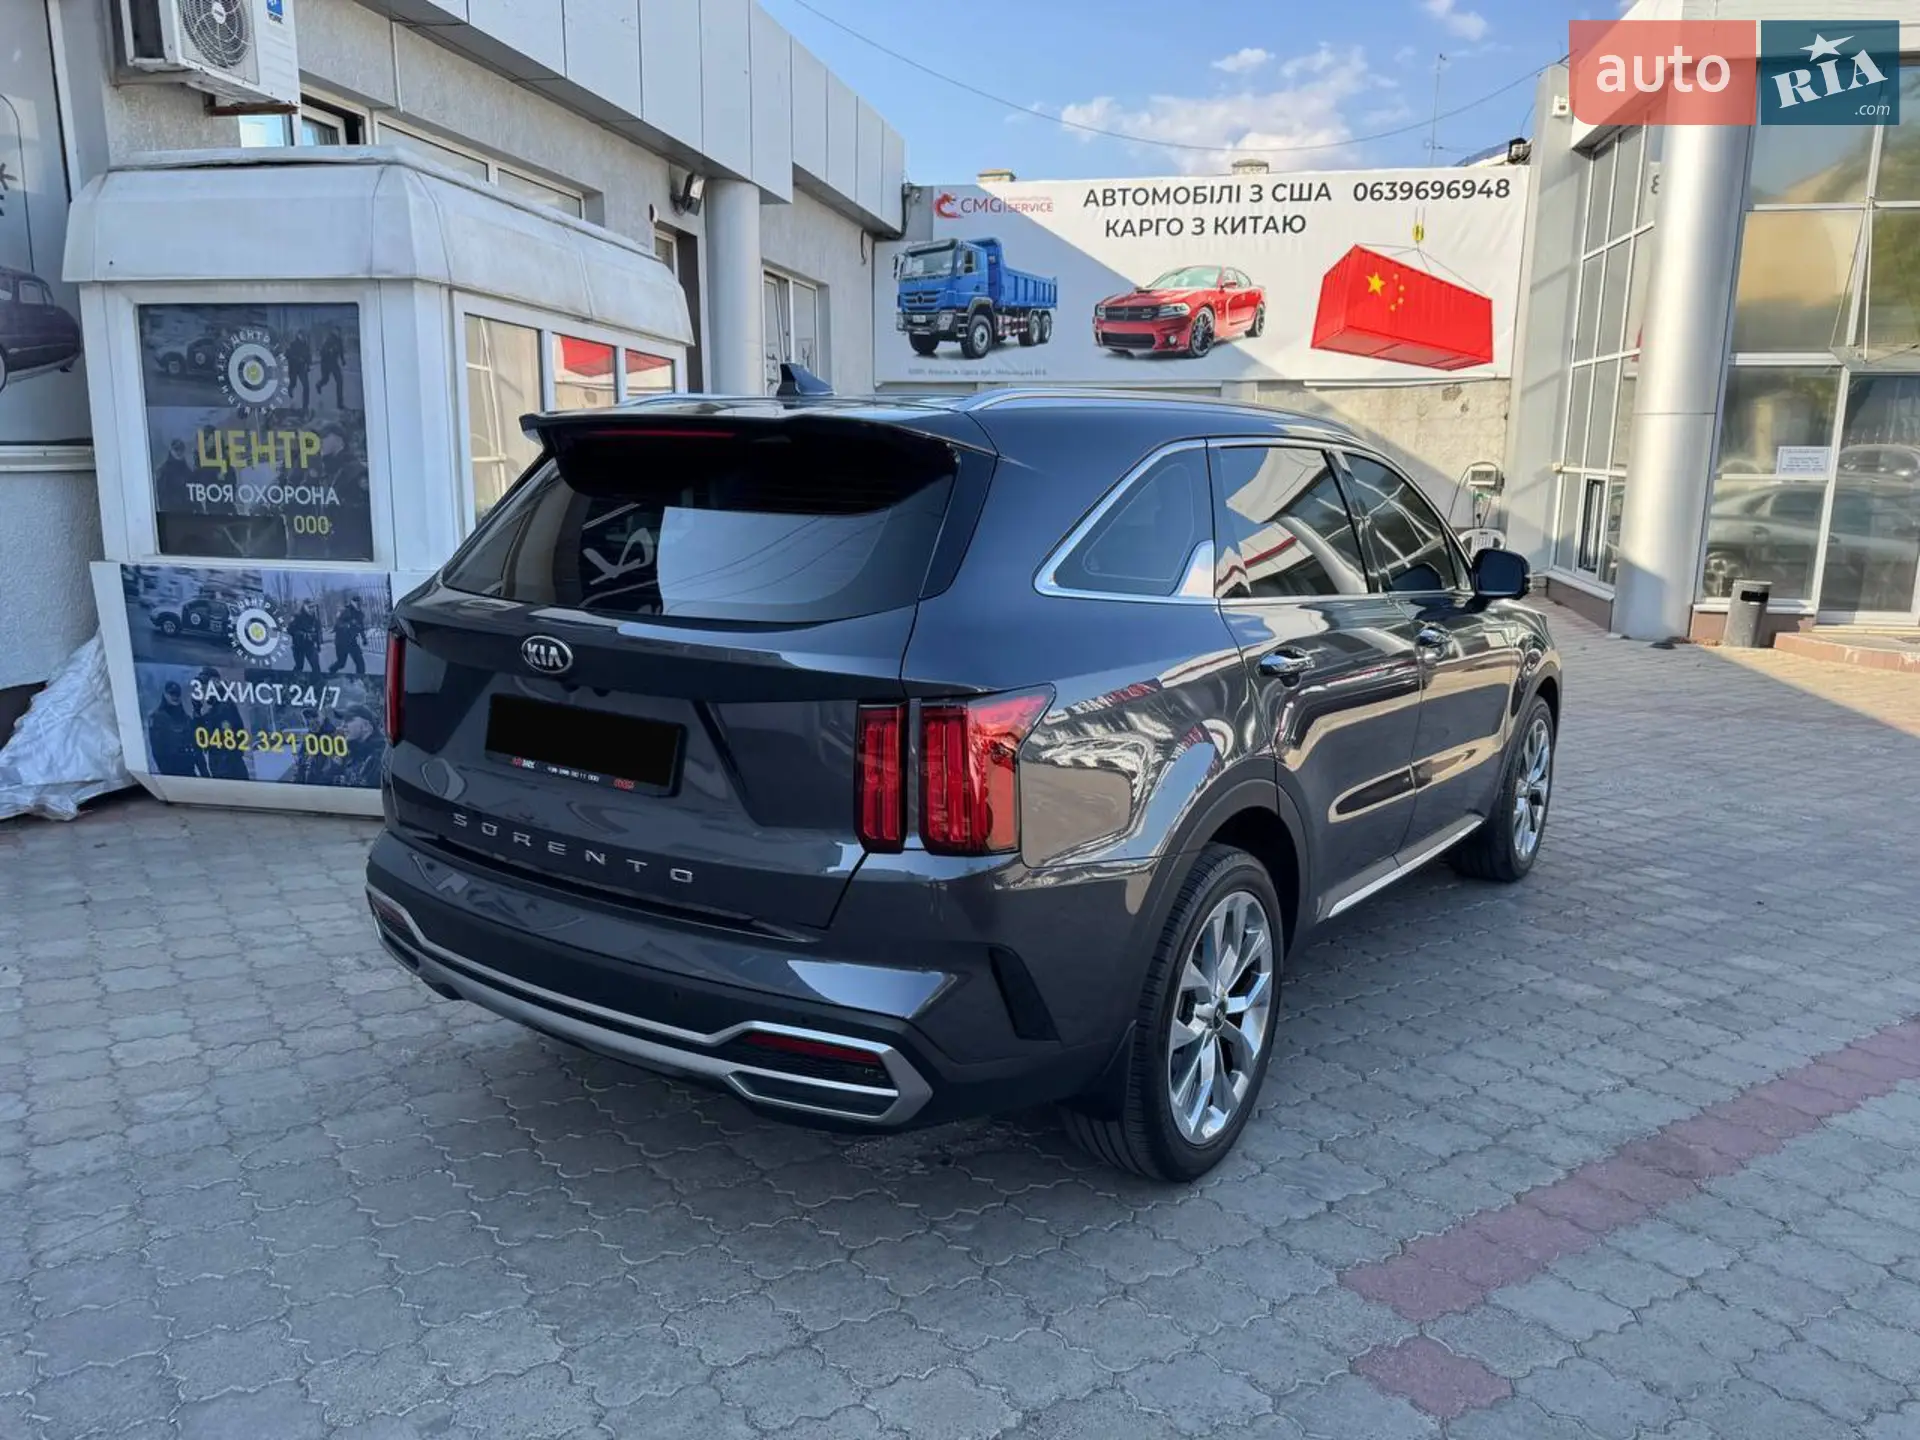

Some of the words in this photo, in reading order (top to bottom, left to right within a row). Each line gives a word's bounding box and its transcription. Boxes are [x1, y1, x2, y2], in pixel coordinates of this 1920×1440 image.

[1083, 184, 1241, 208] АВТОМОБІЛІ
[1249, 183, 1263, 203] З
[1272, 182, 1332, 203] США
[1353, 178, 1511, 202] 0639696948
[1007, 202, 1054, 213] SERVICE
[1105, 217, 1184, 238] КАРГО
[1191, 216, 1206, 236] З
[1214, 214, 1307, 236] КИТАЮ
[197, 429, 321, 481] ЦЕНТР
[186, 483, 234, 503] ТВОЯ
[238, 484, 340, 506] ОХОРОНА
[293, 515, 329, 535] 000
[526, 642, 564, 669] KIA
[190, 679, 283, 705] ЗАХИСТ
[289, 684, 341, 711] 24/7
[195, 726, 249, 751] 0482
[257, 730, 298, 754] 321
[305, 734, 348, 757] 000
[453, 812, 693, 884] SORENTO
